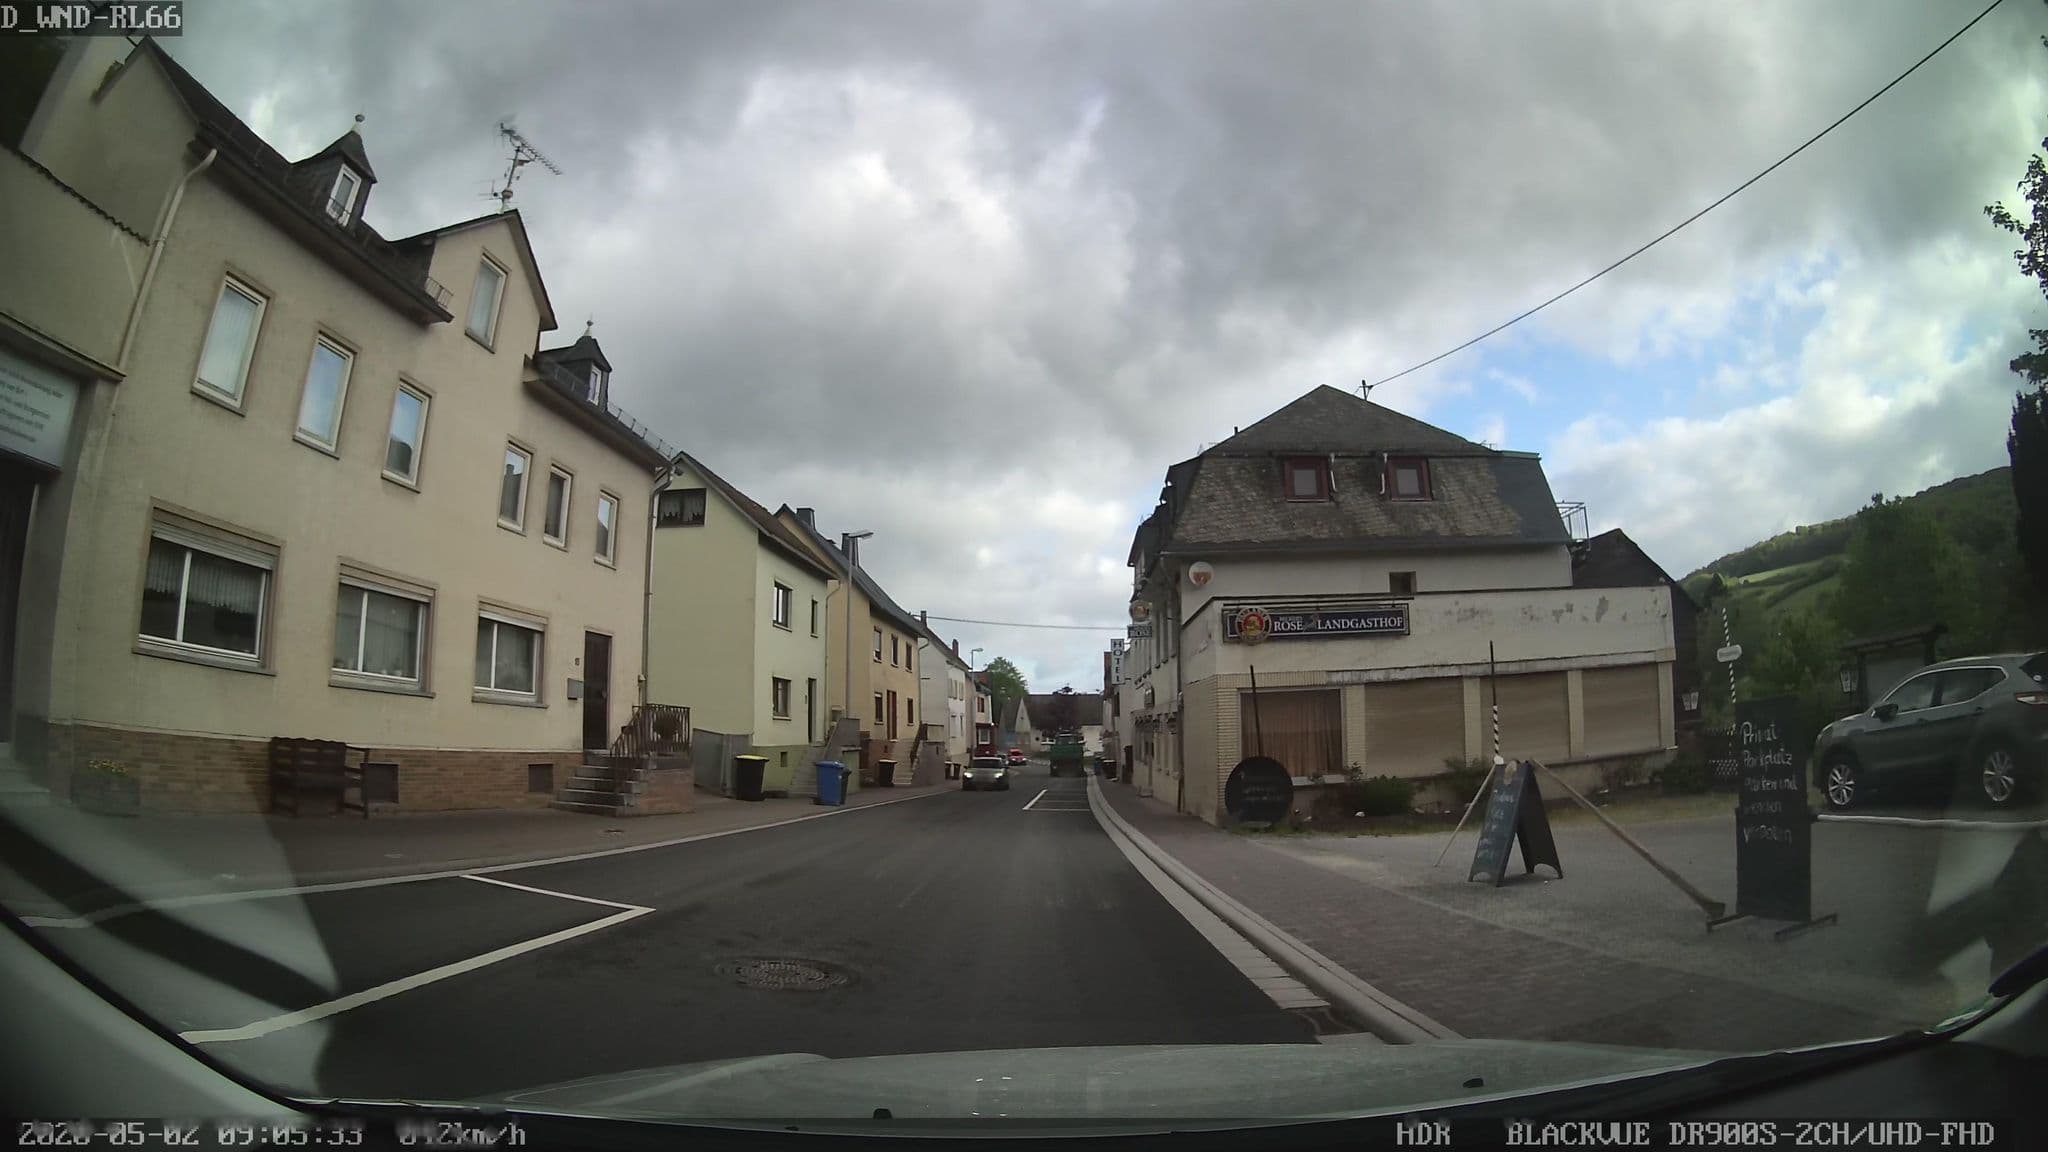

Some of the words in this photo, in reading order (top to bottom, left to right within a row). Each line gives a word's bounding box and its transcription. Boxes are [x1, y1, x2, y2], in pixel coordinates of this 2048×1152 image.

[1274, 620, 1304, 632] ROSE
[1318, 616, 1403, 630] LANDGASTHOF
[1113, 640, 1123, 682] HOTEL
